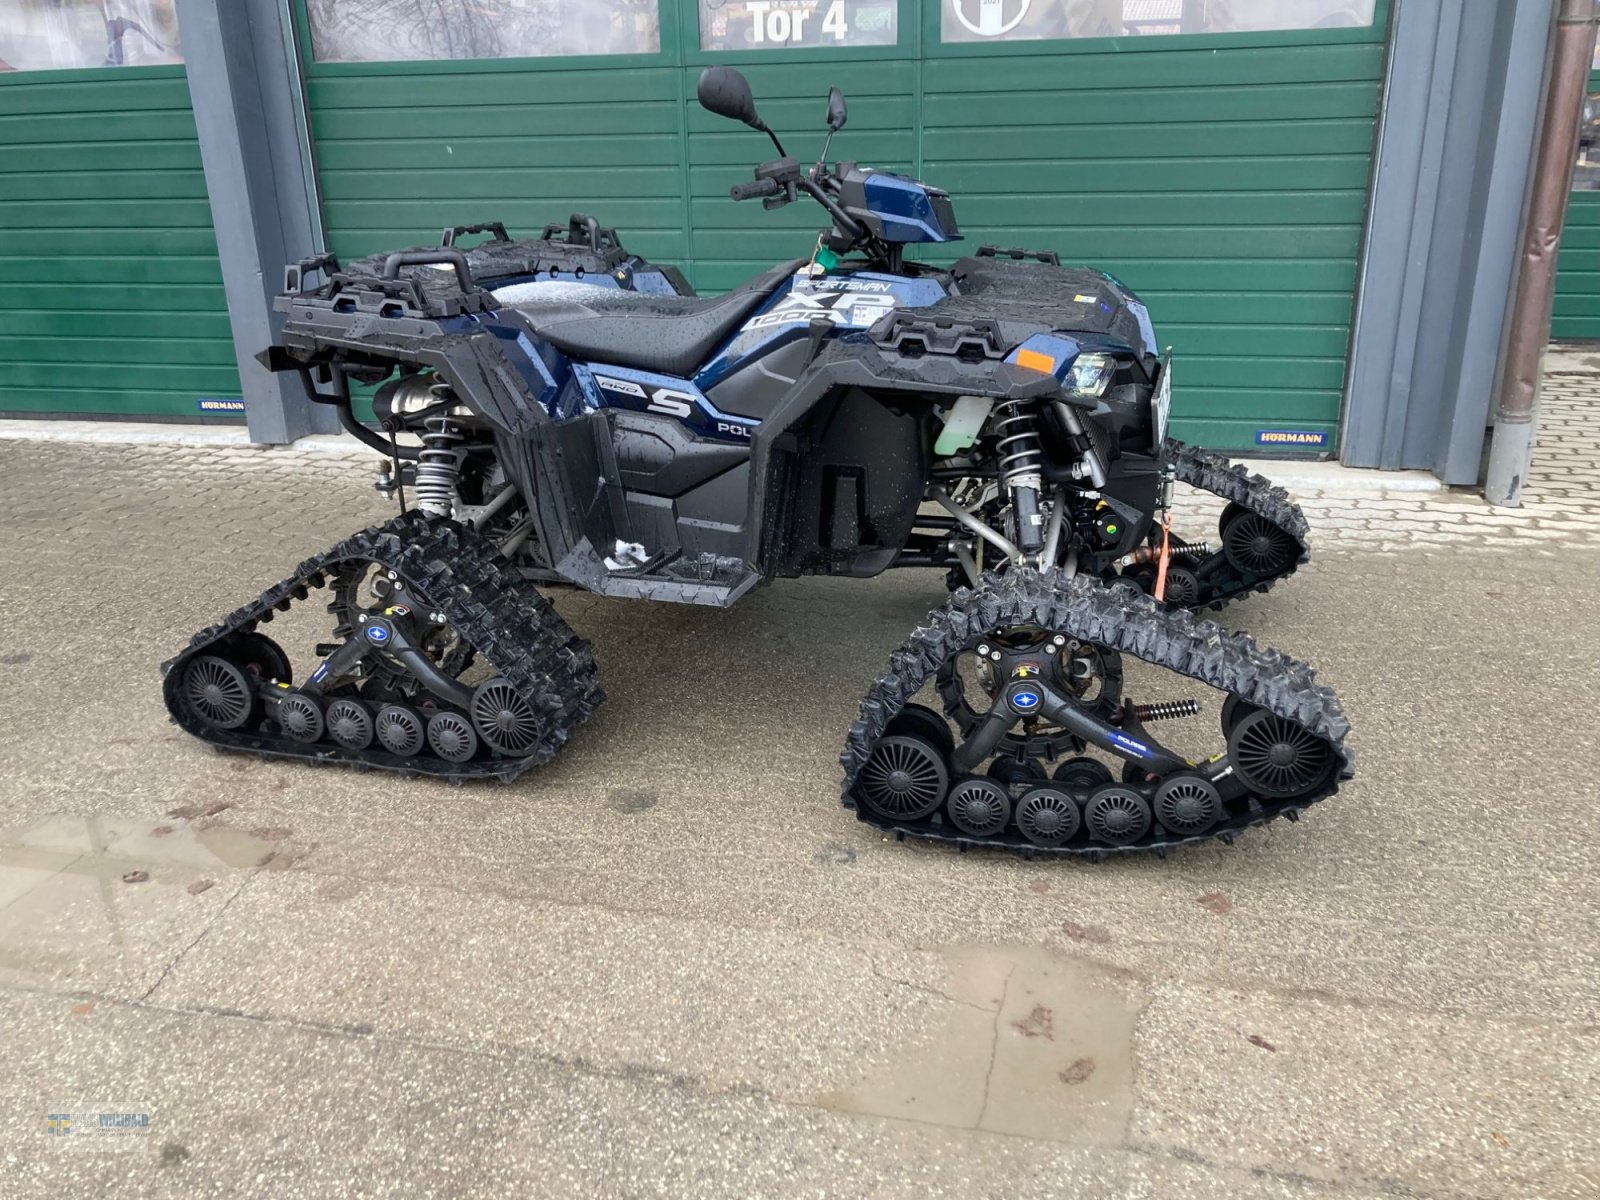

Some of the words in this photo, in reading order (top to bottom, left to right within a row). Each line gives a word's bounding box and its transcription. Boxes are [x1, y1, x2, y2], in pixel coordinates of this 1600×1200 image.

[746, 1, 809, 42] Tor
[822, 0, 848, 40] 4
[796, 279, 891, 293] SPORTSMAN
[773, 292, 896, 311] XP
[647, 388, 698, 419] S
